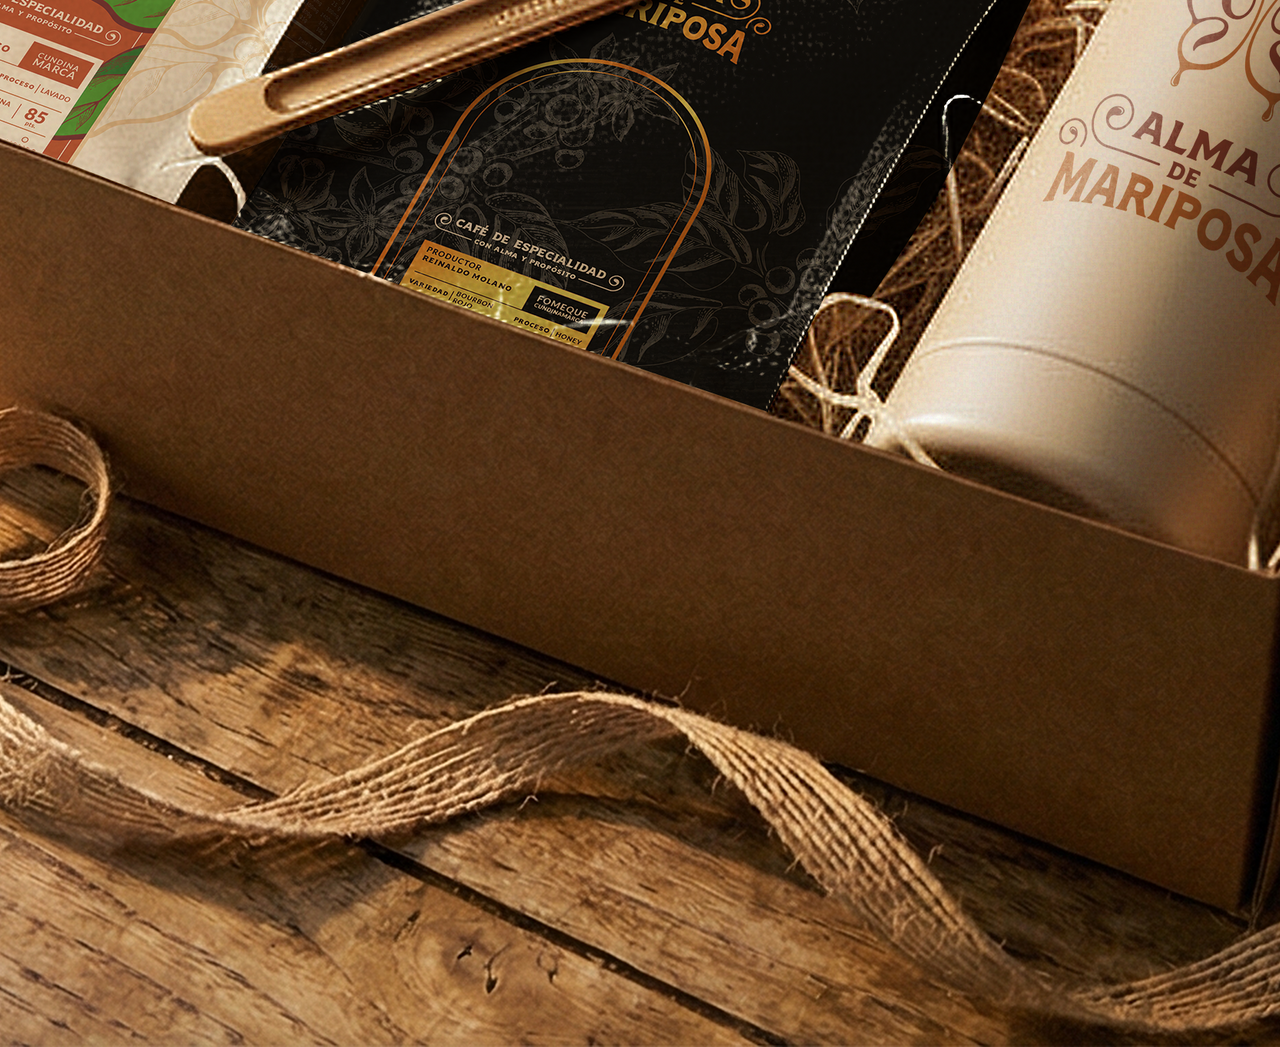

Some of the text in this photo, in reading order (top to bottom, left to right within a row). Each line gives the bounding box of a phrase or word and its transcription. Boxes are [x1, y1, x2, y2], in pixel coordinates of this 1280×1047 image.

[26, 13, 73, 34] PROPÓSITO
[32, 58, 75, 80] MARCA
[37, 52, 79, 72] CUNDINA
[40, 87, 71, 103] LAVADO
[24, 107, 49, 124] 85
[24, 121, 36, 129] pts.
[1131, 110, 1259, 187] ALMA
[1166, 161, 1202, 188] DE
[426, 246, 482, 272] PRODUCTOR
[456, 218, 607, 279] CAFÉ DE ESPECIALIDAD
[473, 239, 492, 249] CON
[493, 246, 518, 259] ALMA
[529, 258, 577, 280] PROPÓSITO
[422, 255, 513, 292] REINALDO MOLANO
[409, 277, 494, 309] VARIEDAD BOURBON
[452, 298, 473, 309] ROJO
[533, 302, 584, 324] CUNDINAMARCA
[536, 294, 589, 319] FOMEQUE
[513, 316, 583, 345] PROCESO HONEY
